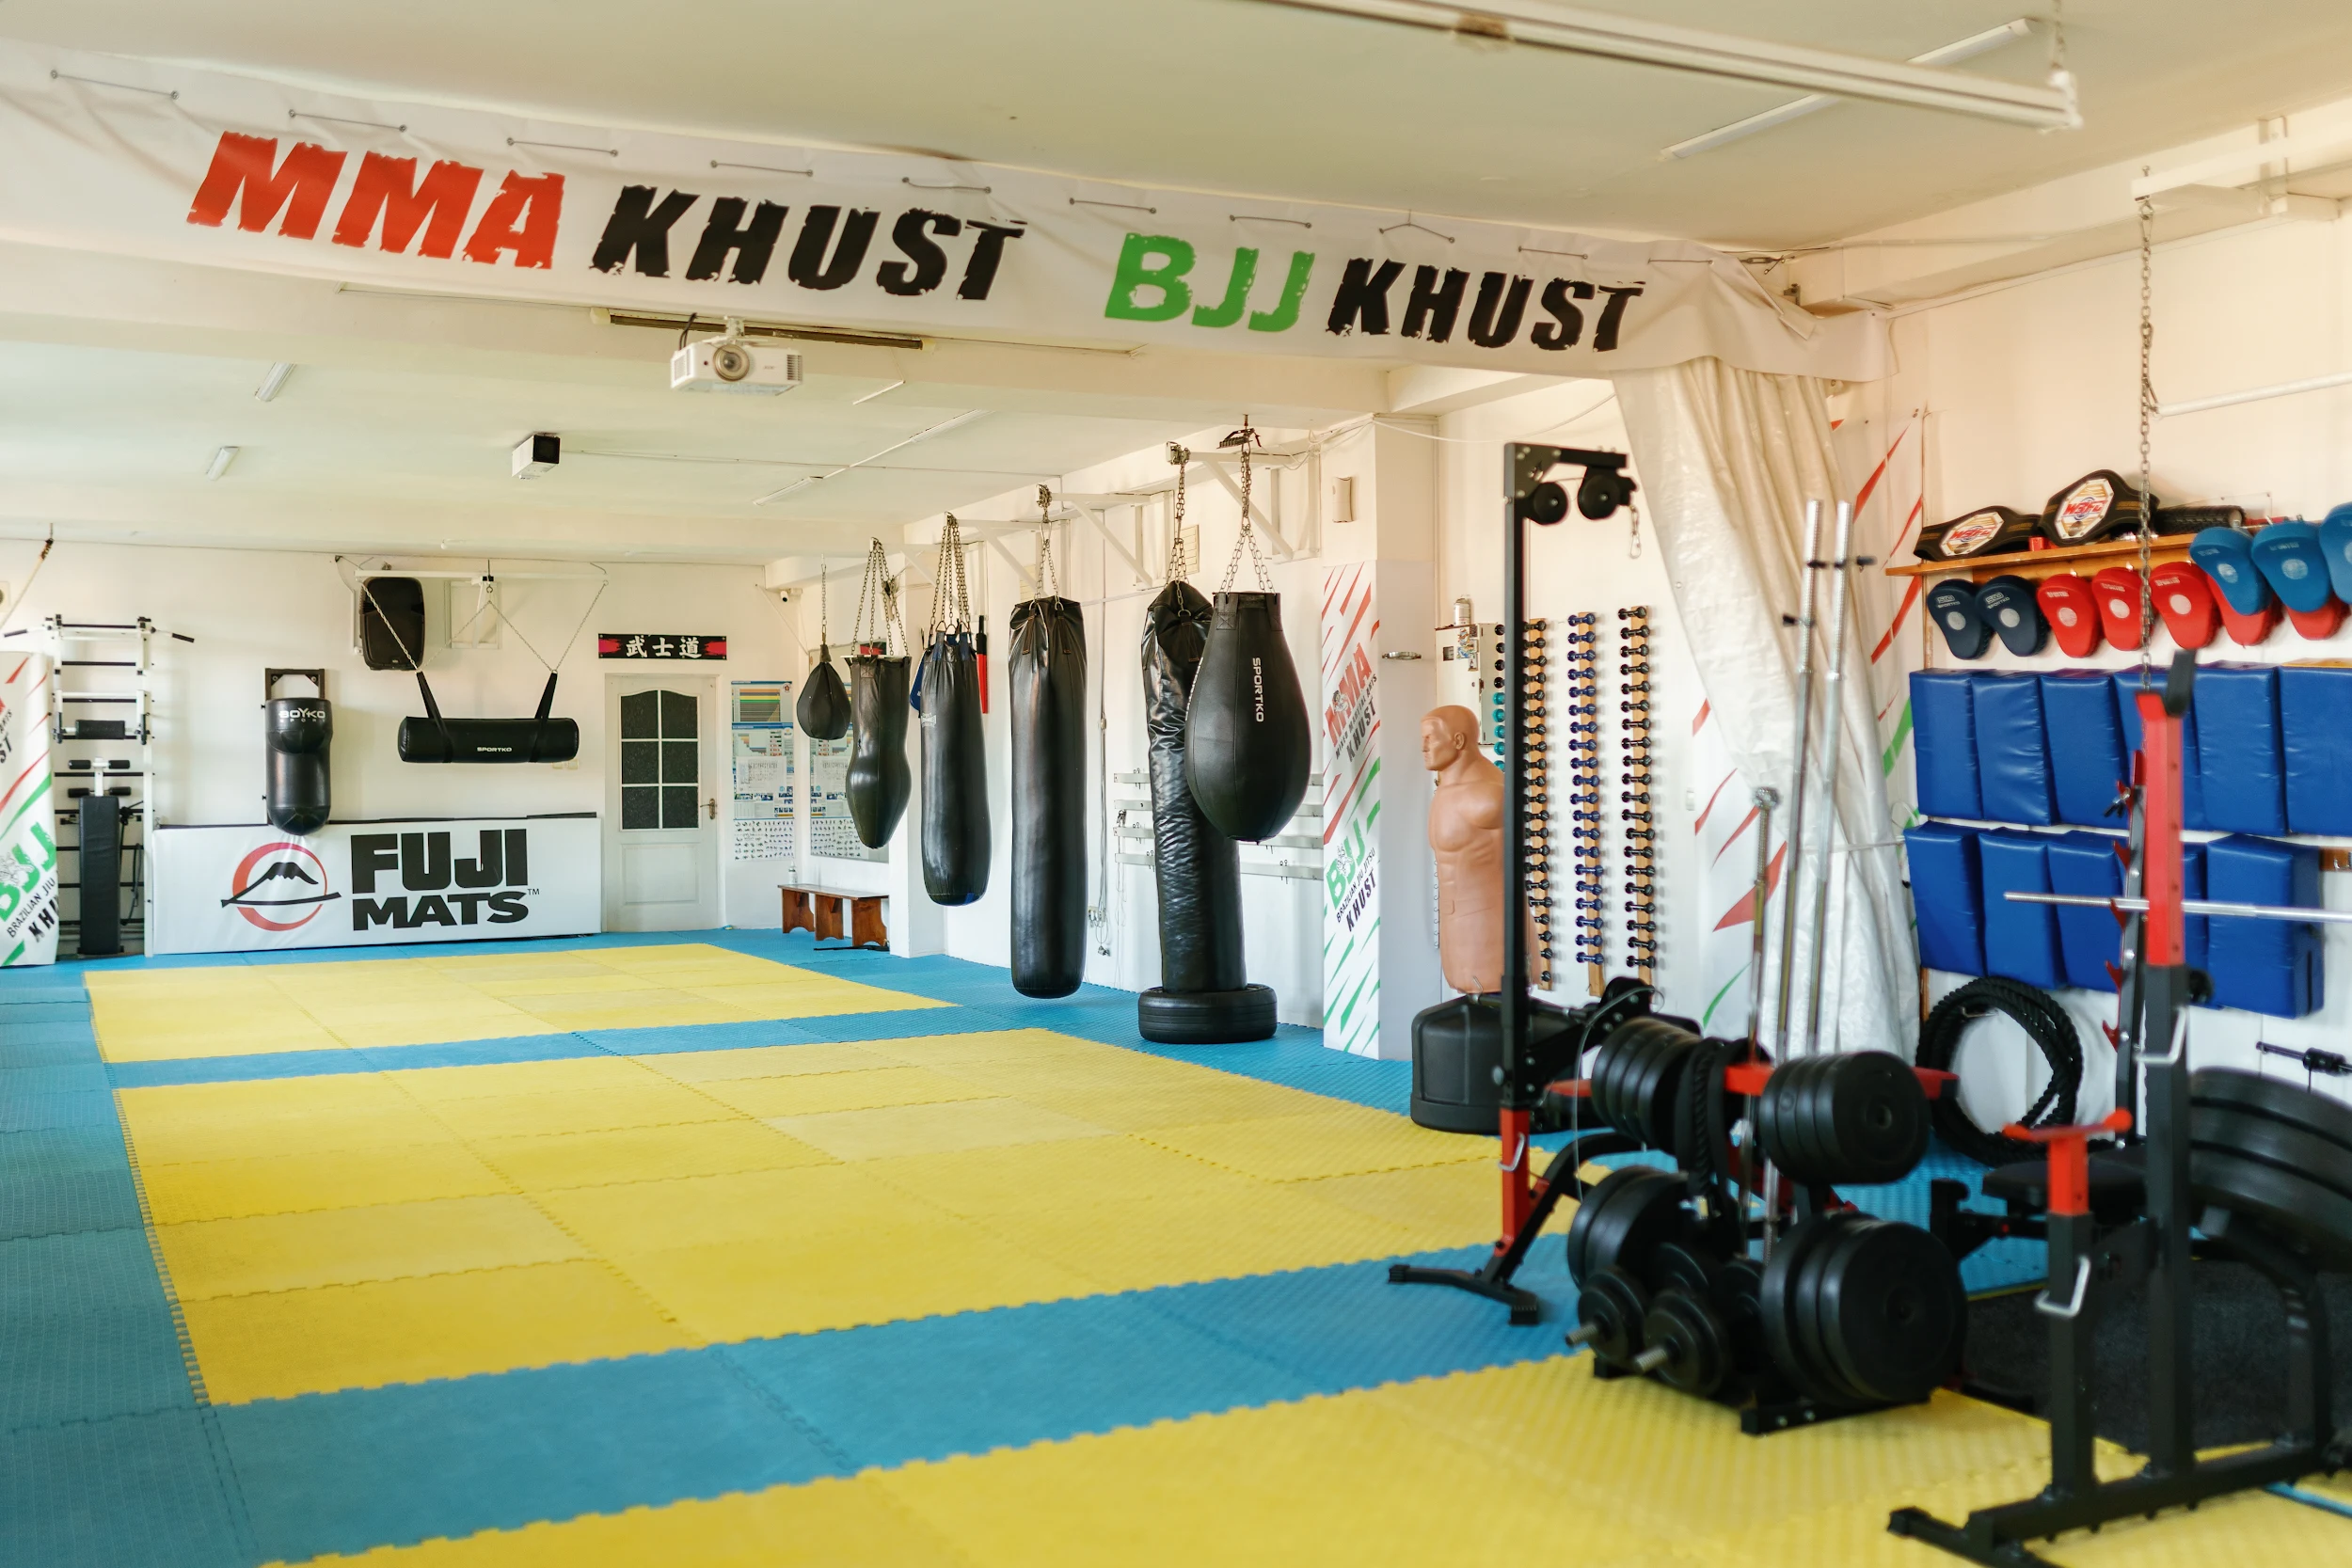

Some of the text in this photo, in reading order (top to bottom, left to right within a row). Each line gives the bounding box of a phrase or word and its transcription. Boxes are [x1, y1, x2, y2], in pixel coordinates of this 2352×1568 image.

[187, 132, 1645, 353] MMA KHUST BJJ KHUST
[626, 636, 702, 658] 武士道
[278, 707, 326, 718] BOYKO
[1252, 657, 1264, 722] SPORTKO
[1325, 642, 1372, 747] MMA
[1346, 697, 1375, 762] KHUST
[351, 829, 528, 894] FUJI
[1327, 817, 1365, 911] BJJ
[1337, 882, 1357, 923] BRAZILIAN
[1364, 847, 1375, 874] JITSU
[7, 878, 56, 938] BRAZILIAN JIU
[353, 891, 529, 931] MATS
[1346, 868, 1375, 932] KHUST
